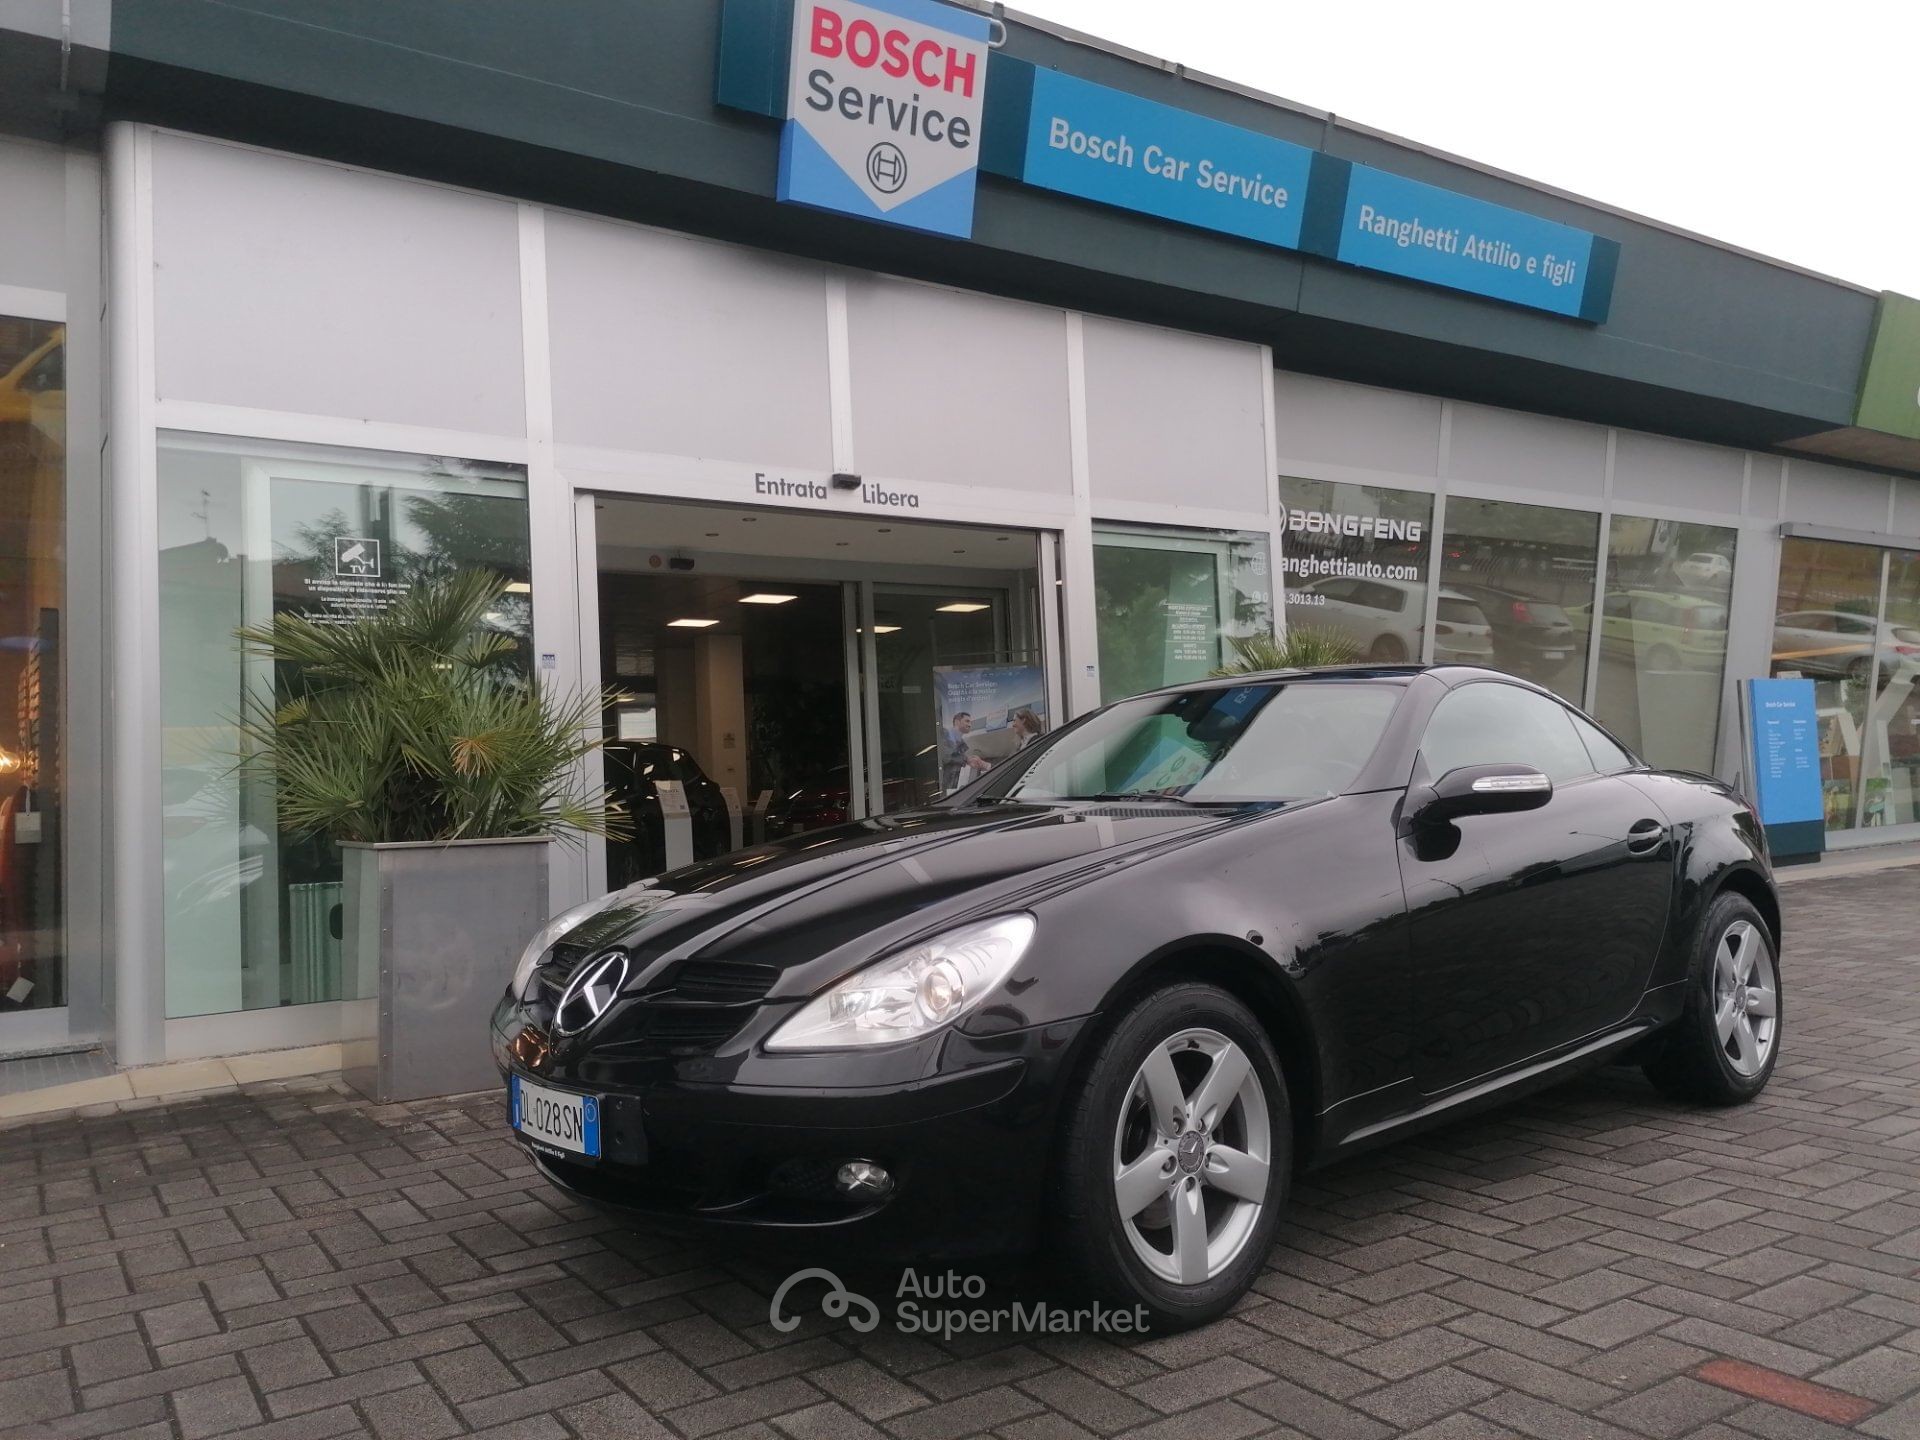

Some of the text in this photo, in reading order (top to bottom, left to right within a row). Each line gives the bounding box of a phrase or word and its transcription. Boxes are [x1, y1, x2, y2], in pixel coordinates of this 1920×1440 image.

[811, 6, 976, 98] BOSCH
[805, 69, 971, 149] Service
[1049, 117, 1289, 209] Bosch Car Service
[1358, 204, 1577, 287] Ranghetti Attilio e figli
[755, 472, 919, 508] Entrata Libera
[1289, 509, 1422, 542] DONGFENG
[350, 564, 366, 574] TV
[1281, 554, 1418, 581] anghettiauto.com
[536, 1097, 583, 1143] 028SN
